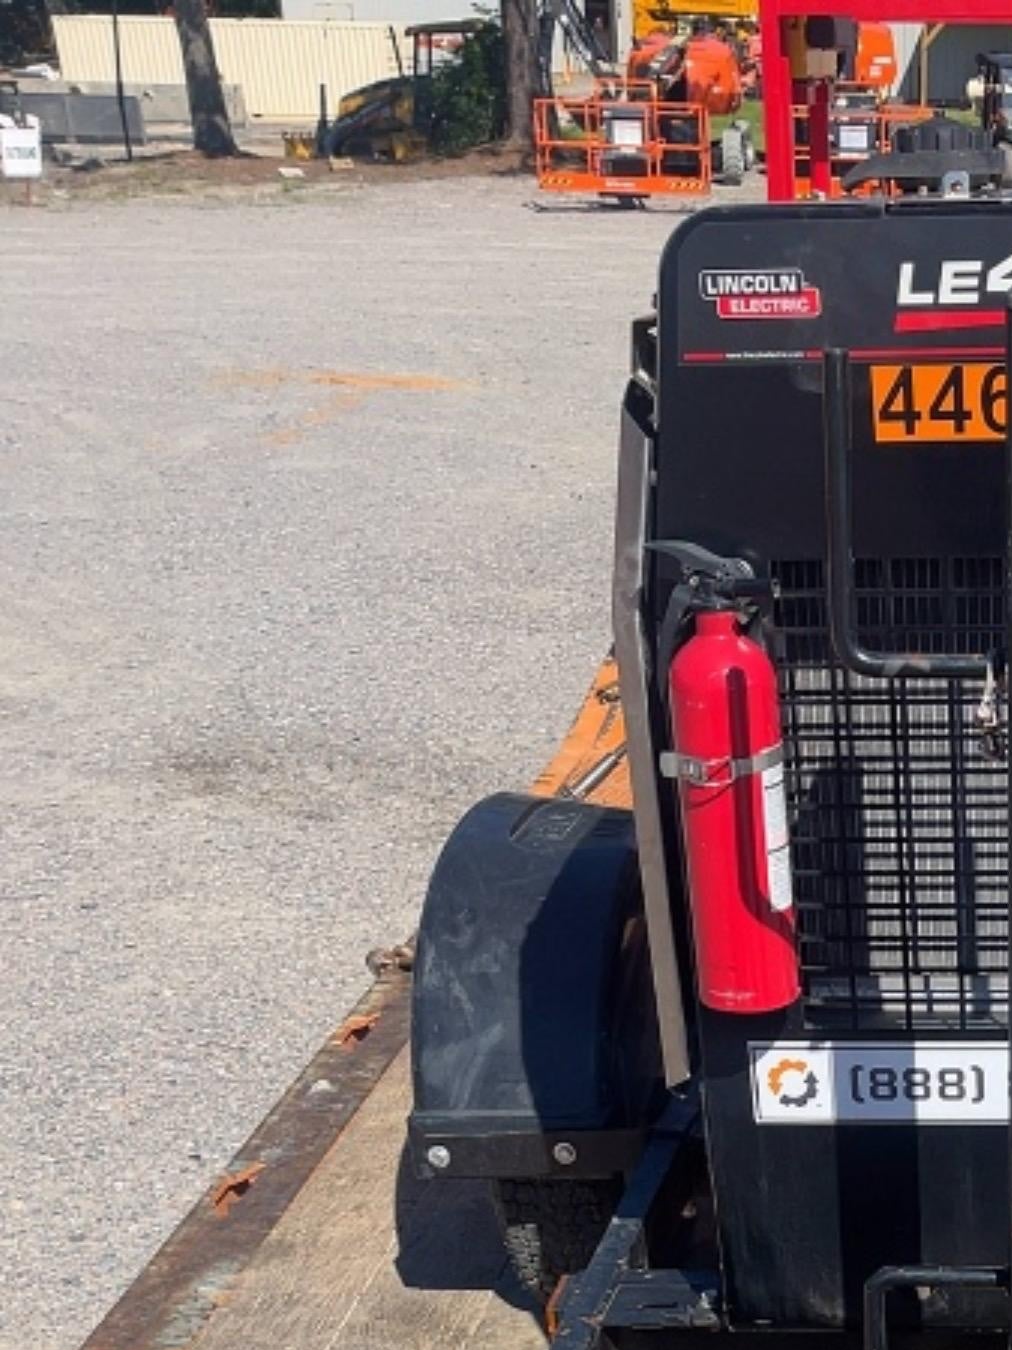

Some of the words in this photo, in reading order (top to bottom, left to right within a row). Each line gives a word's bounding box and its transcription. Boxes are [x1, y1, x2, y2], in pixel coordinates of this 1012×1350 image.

[705, 274, 797, 295] LINCOLN
[729, 297, 811, 314] ELECTRIC
[851, 1064, 985, 1104] (888)
